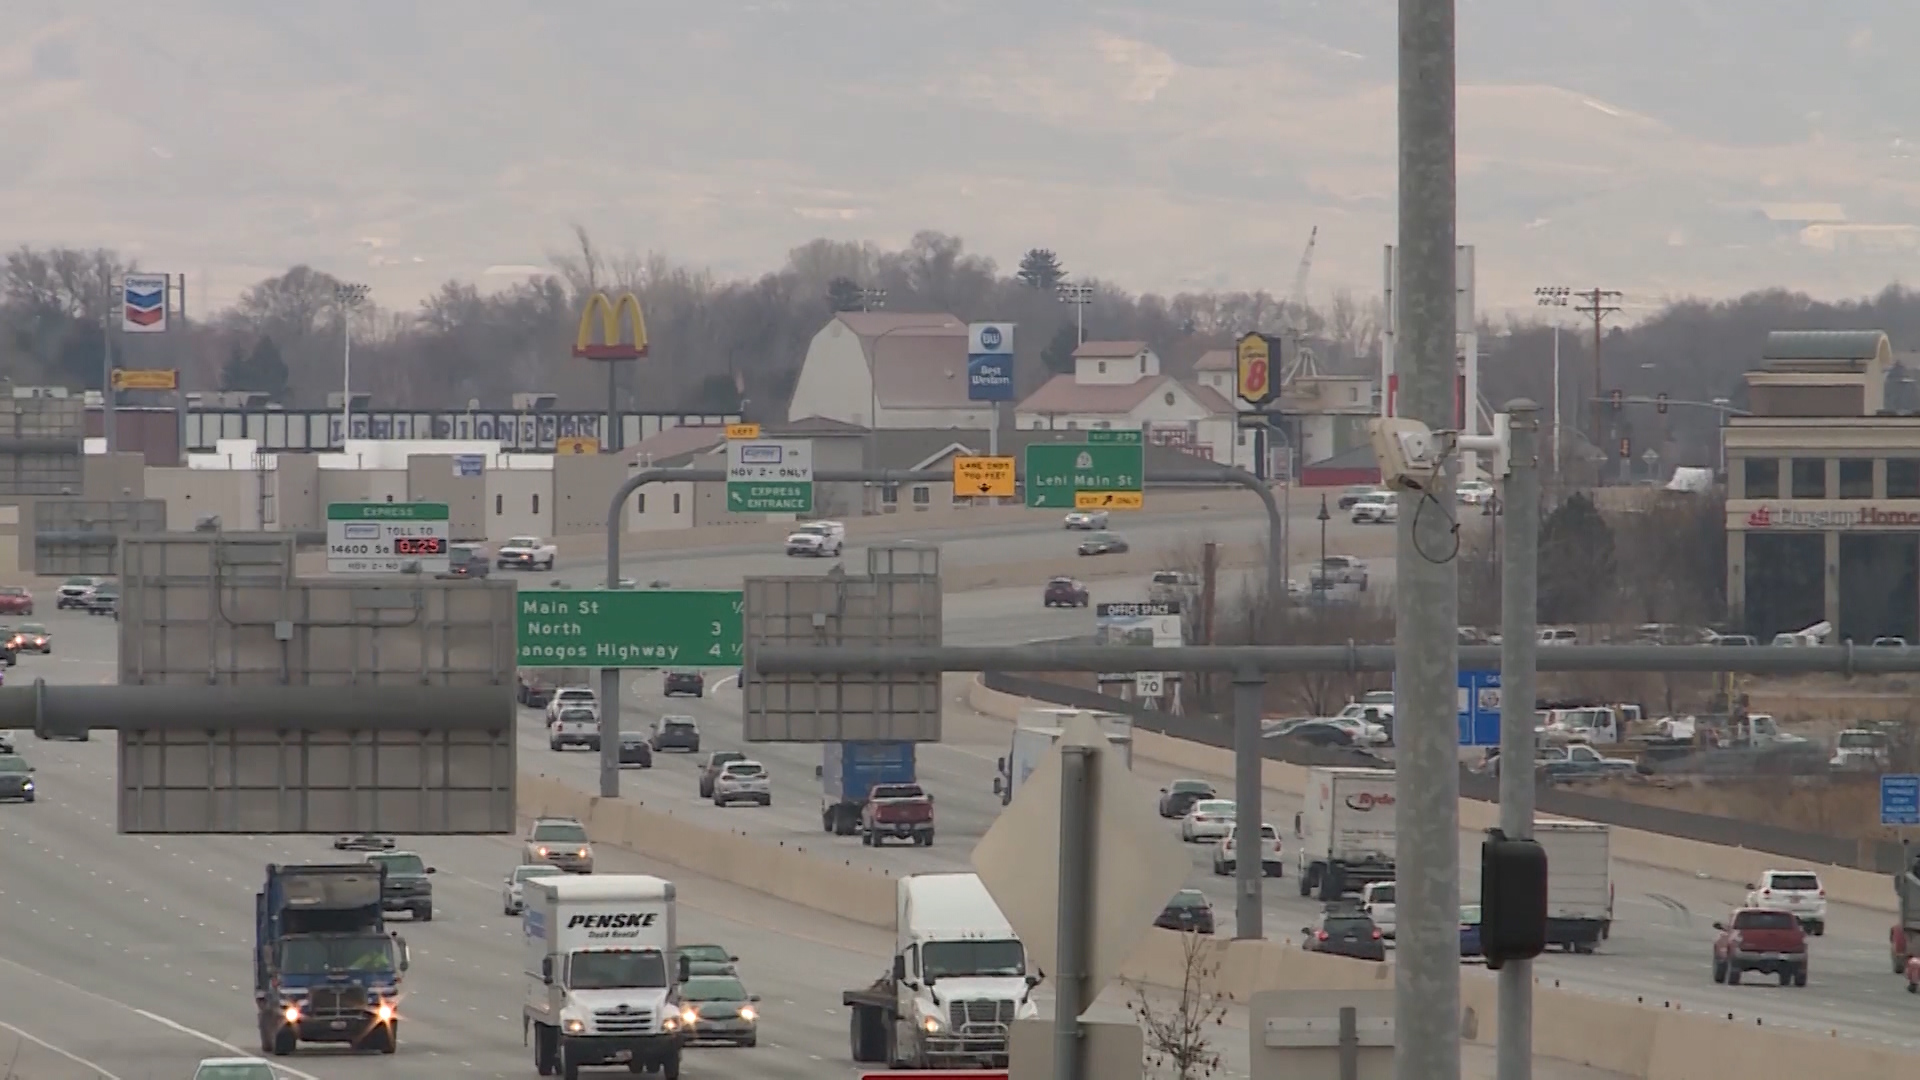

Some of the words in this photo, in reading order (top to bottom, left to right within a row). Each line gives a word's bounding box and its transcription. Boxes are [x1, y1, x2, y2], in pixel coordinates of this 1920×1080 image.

[981, 364, 1001, 376] Best
[1246, 358, 1267, 393] 8
[971, 374, 1010, 387] Western
[332, 419, 407, 442] LEHI
[731, 427, 753, 436] LEFT
[1116, 432, 1138, 441] 279
[731, 468, 754, 477] HOV
[779, 467, 808, 478] ONLY
[1036, 475, 1068, 487] Lehi
[1074, 475, 1110, 487] Main
[1117, 475, 1133, 487] St
[750, 487, 802, 497] EXPRESS
[747, 499, 806, 509] ENTRANCE
[362, 507, 415, 517] EXPRESS
[386, 526, 415, 536] TOLL
[420, 526, 434, 536] TO
[331, 544, 369, 555] 14600
[523, 600, 569, 615] Main
[578, 600, 600, 615] St
[1107, 604, 1138, 616] OFFICE
[1141, 604, 1169, 616] SPACE
[528, 621, 582, 636] North
[710, 620, 722, 636] 3
[517, 644, 588, 661] anogos
[597, 643, 679, 661] Highway
[708, 643, 722, 656] 4
[1143, 681, 1160, 693] 70
[1358, 793, 1396, 807] Ryde
[567, 912, 659, 929] PENSKE
